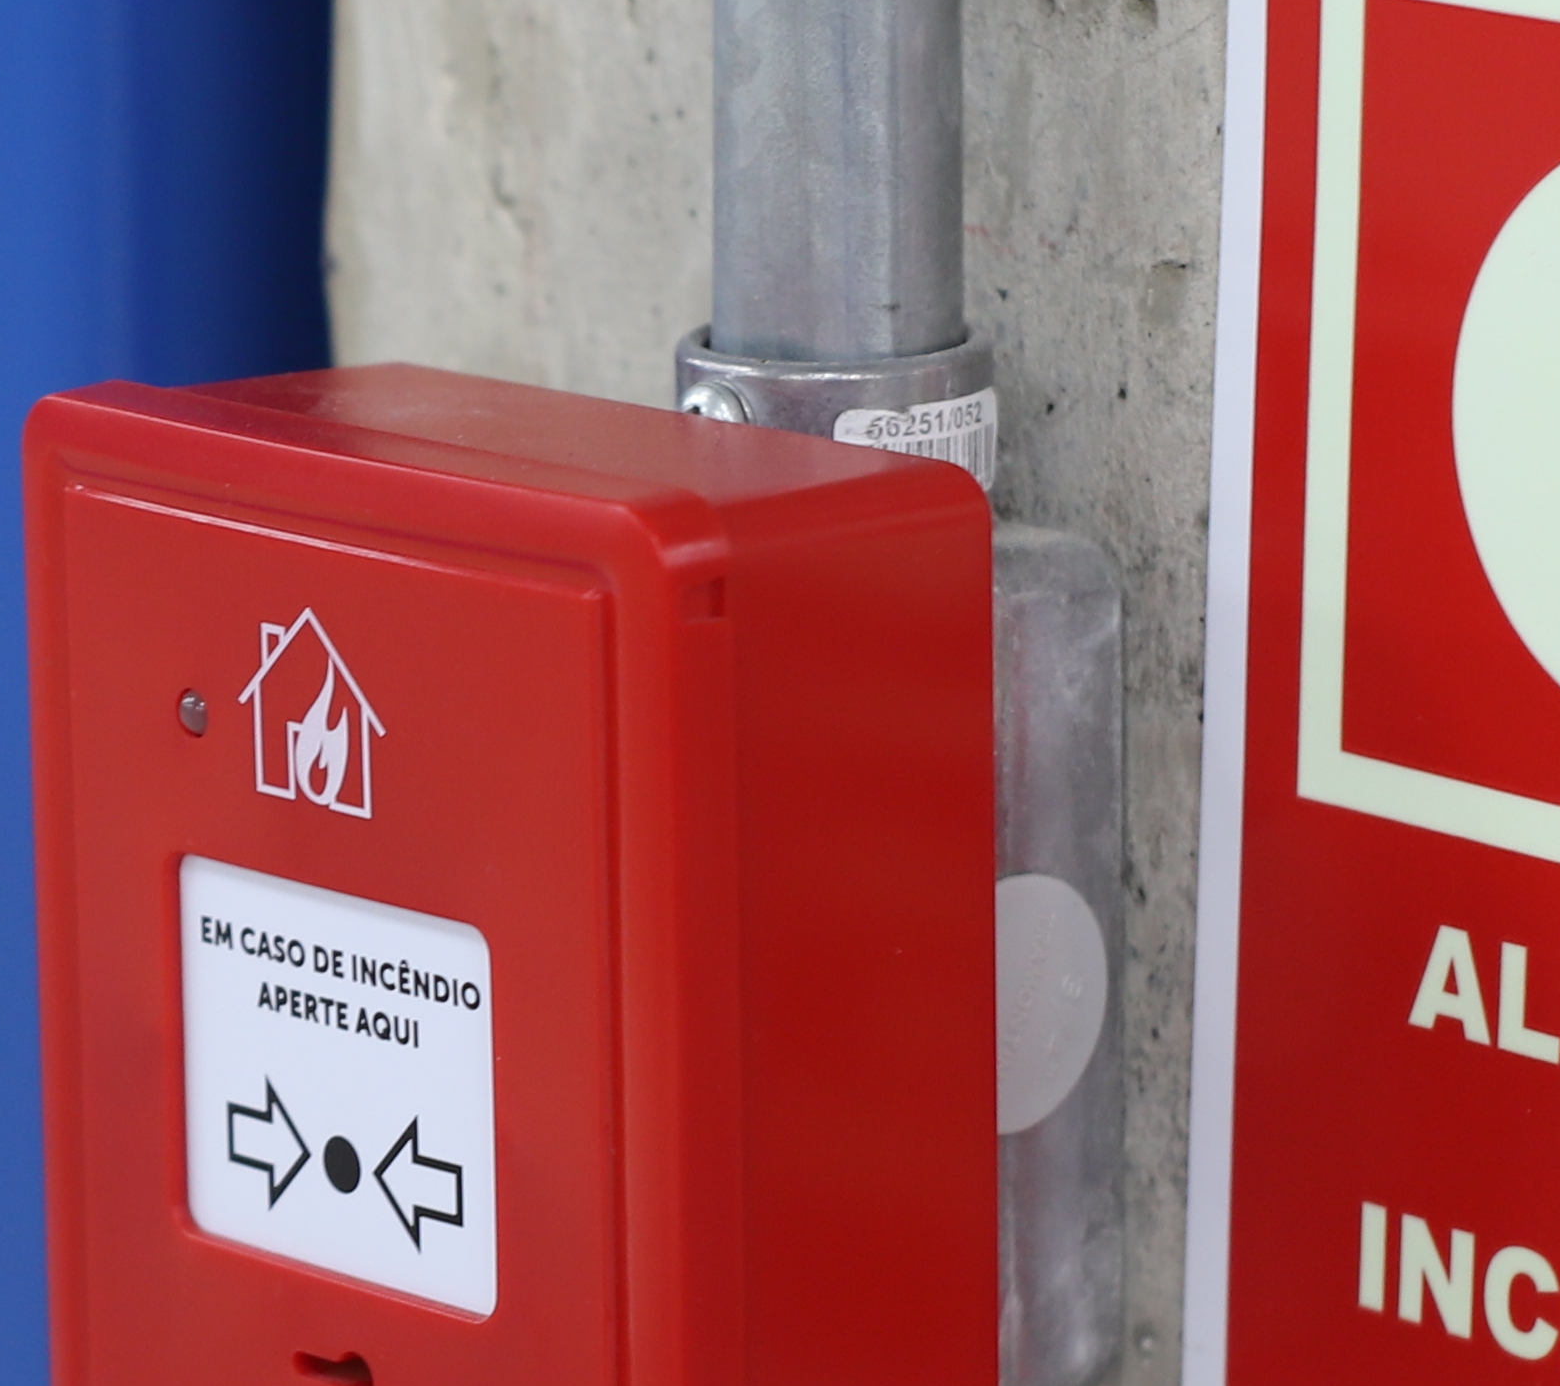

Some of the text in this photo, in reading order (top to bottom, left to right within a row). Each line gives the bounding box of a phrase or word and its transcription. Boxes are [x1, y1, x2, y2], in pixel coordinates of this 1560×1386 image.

[201, 916, 481, 1011] EM CASO DE INCÊNDIO
[257, 982, 420, 1049] APERTE AQUI
